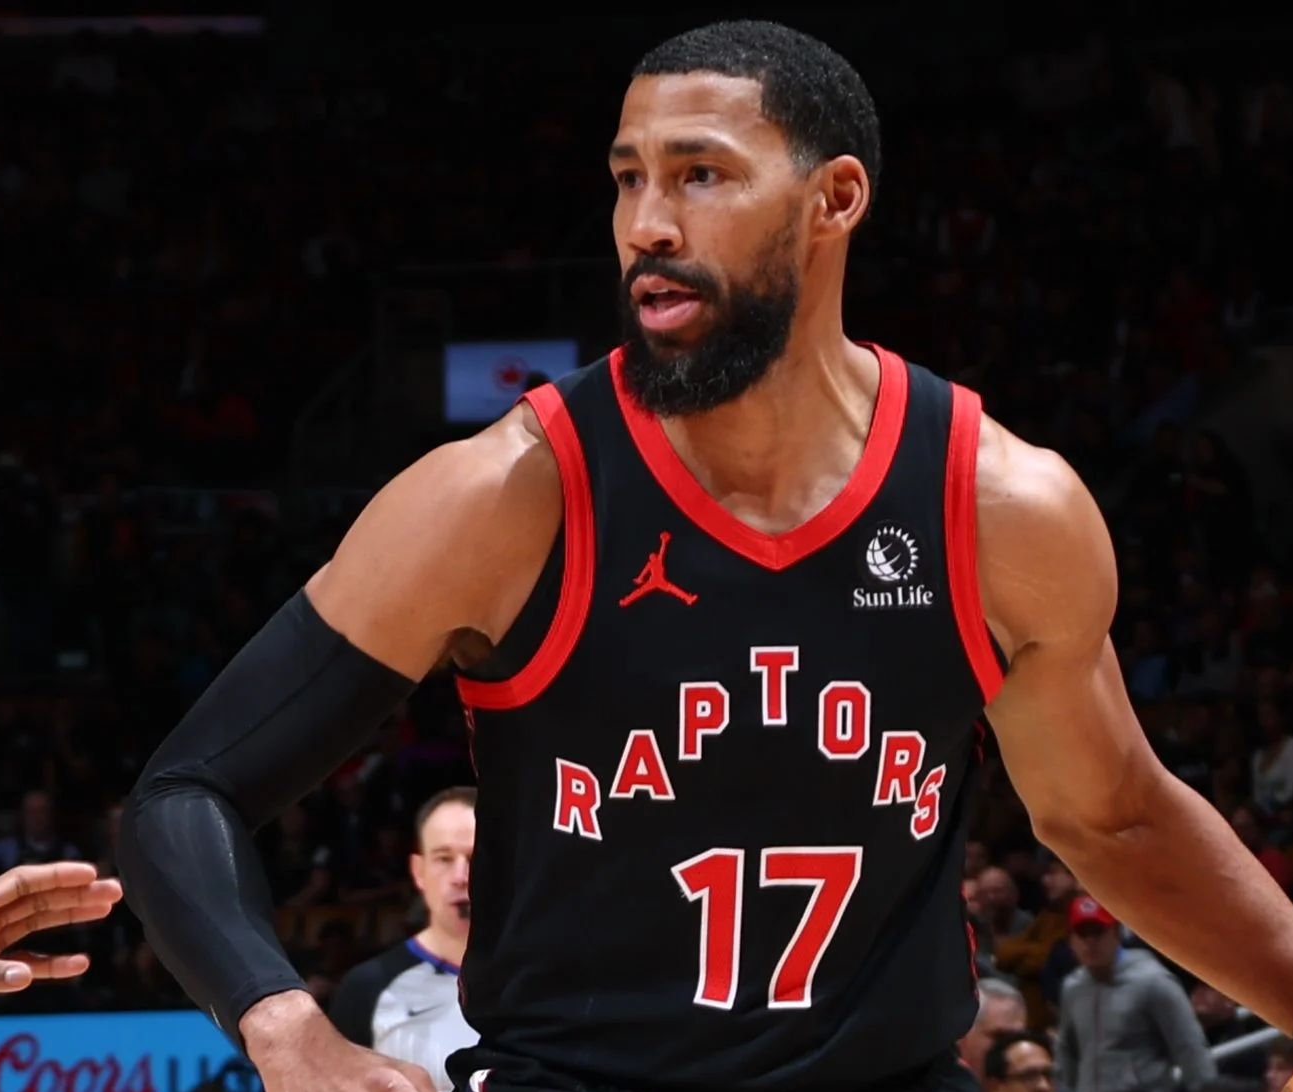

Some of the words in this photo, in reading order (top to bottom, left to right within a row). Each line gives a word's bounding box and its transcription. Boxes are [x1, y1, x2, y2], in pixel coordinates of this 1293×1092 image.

[853, 587, 894, 608] Sun
[896, 584, 934, 607] Life
[553, 645, 947, 841] RAPTORS
[670, 846, 864, 1010] 17
